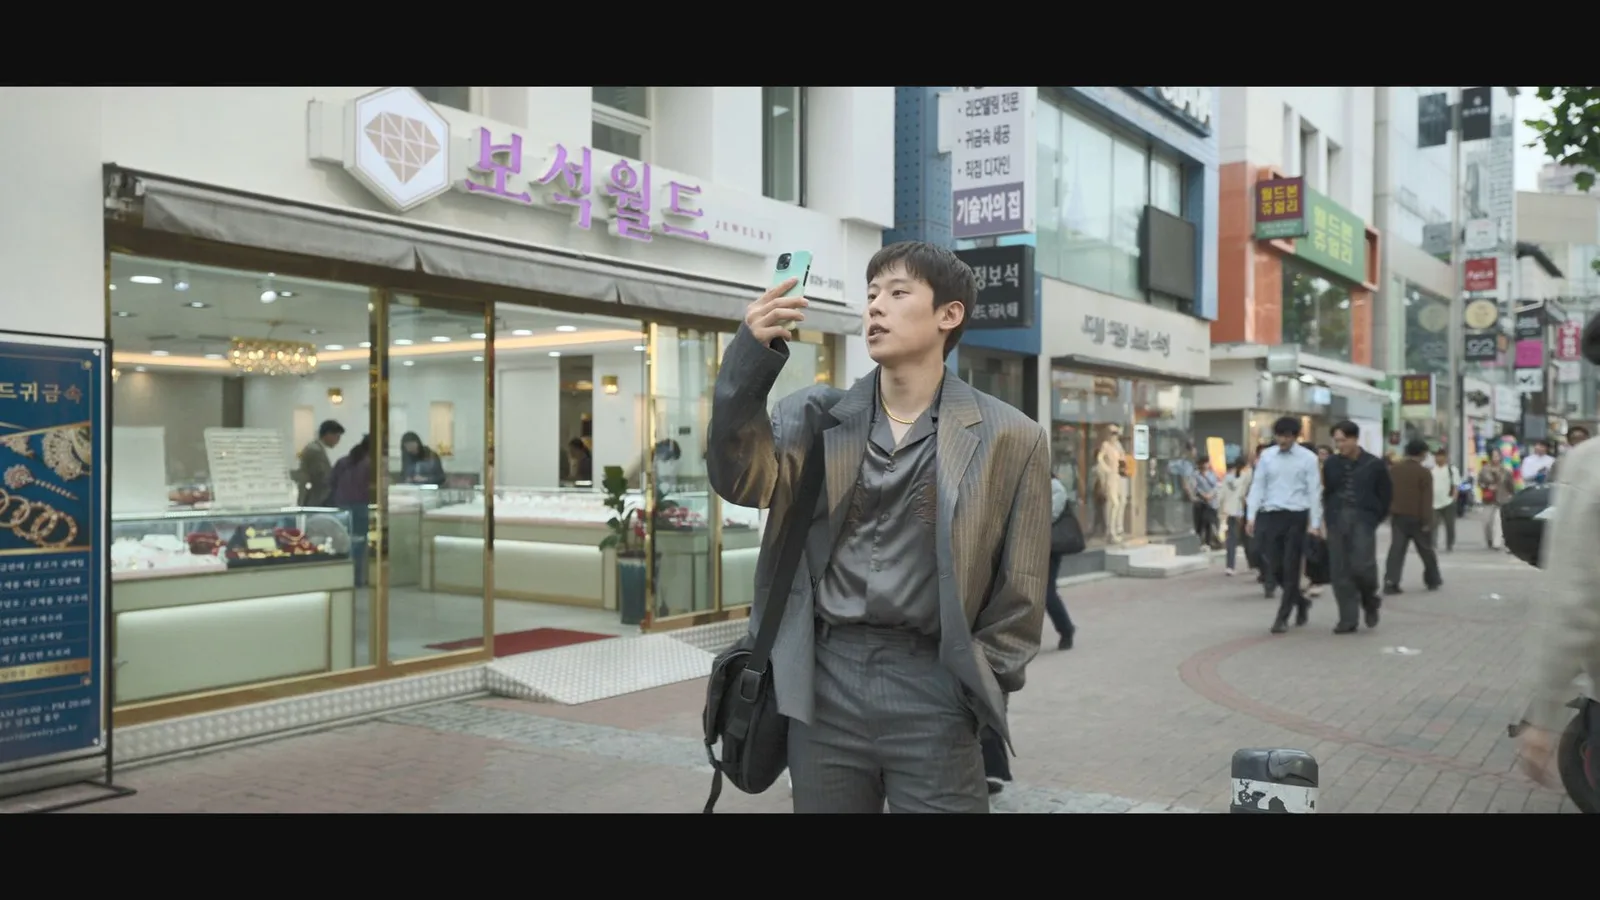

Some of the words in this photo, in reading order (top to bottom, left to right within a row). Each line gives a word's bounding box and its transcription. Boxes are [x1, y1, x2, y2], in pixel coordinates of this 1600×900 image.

[965, 95, 999, 118] 리모델링
[1001, 91, 1019, 113] 전문
[965, 128, 991, 149] 귀금속
[965, 160, 982, 179] 직접
[984, 154, 1010, 176] 디자인
[464, 127, 708, 241] 보석월드
[957, 191, 1005, 226] 기술자의
[1007, 189, 1020, 220] 집
[715, 220, 772, 241] JEWELRY
